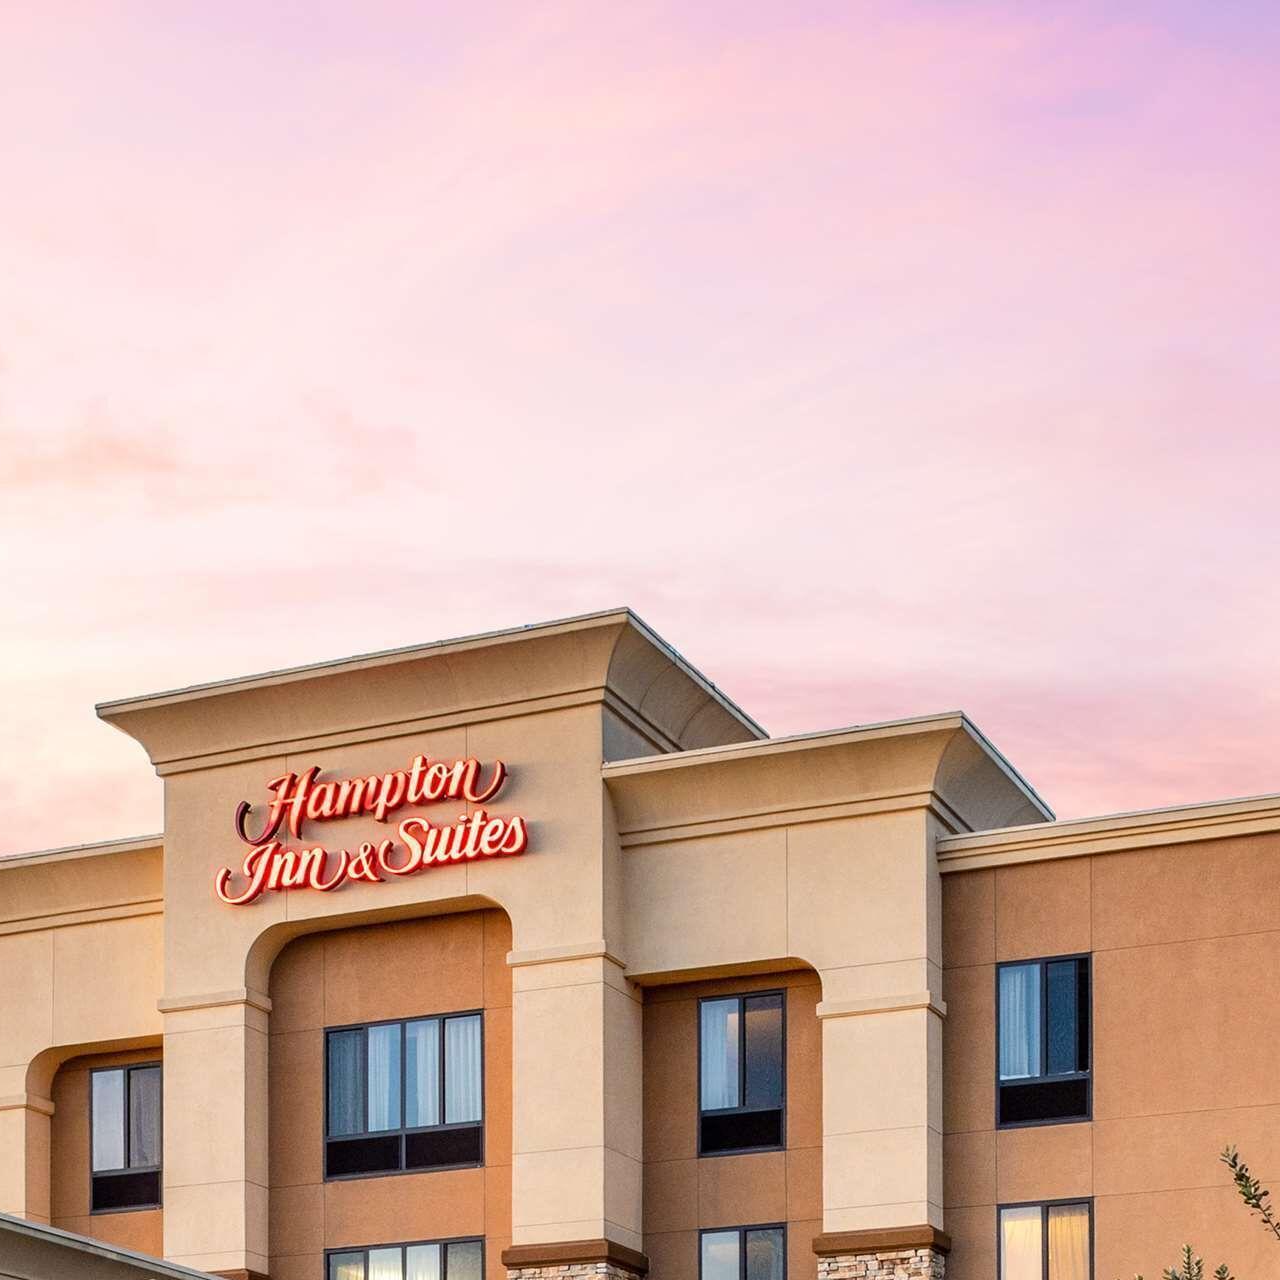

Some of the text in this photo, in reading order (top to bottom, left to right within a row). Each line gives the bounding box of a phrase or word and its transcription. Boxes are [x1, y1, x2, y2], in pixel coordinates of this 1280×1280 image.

[232, 754, 508, 846] Hampton
[215, 809, 529, 905] Inn & Suites
